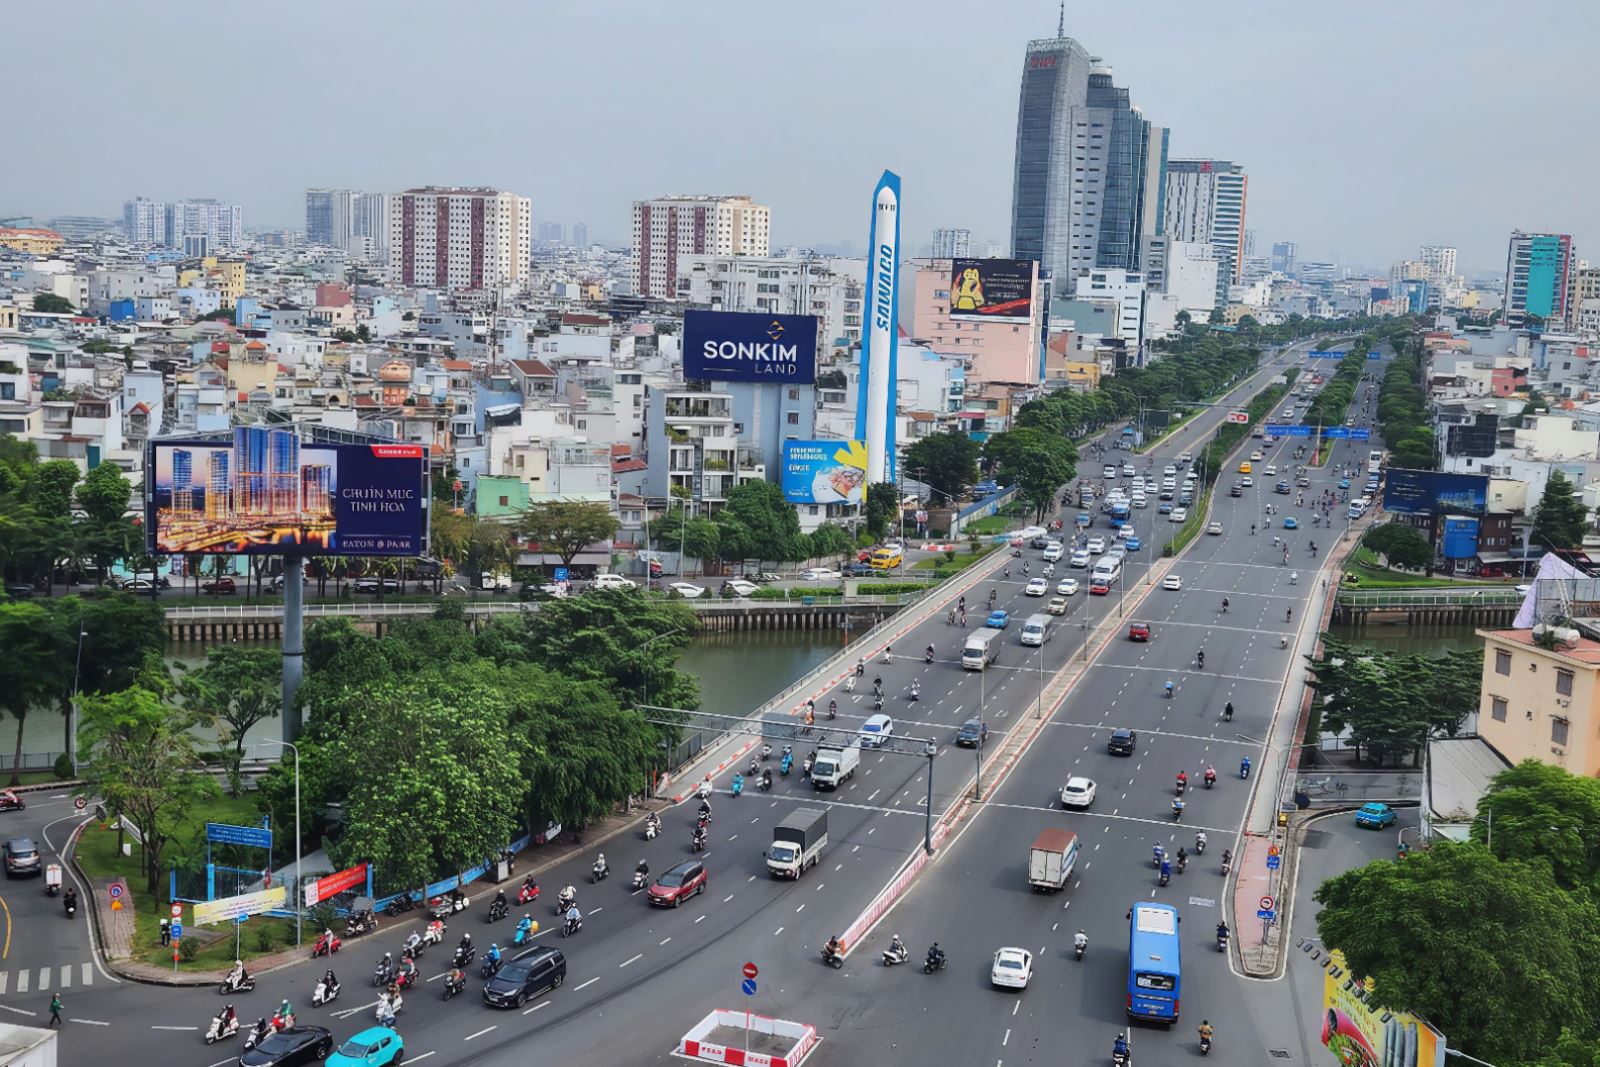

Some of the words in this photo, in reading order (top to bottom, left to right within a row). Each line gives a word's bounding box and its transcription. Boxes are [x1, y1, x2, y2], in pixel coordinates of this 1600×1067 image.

[876, 244, 893, 331] SAWACO
[703, 340, 798, 362] SONKIM
[755, 363, 797, 375] LAND
[350, 501, 376, 512] TINH
[380, 502, 406, 512] HOA
